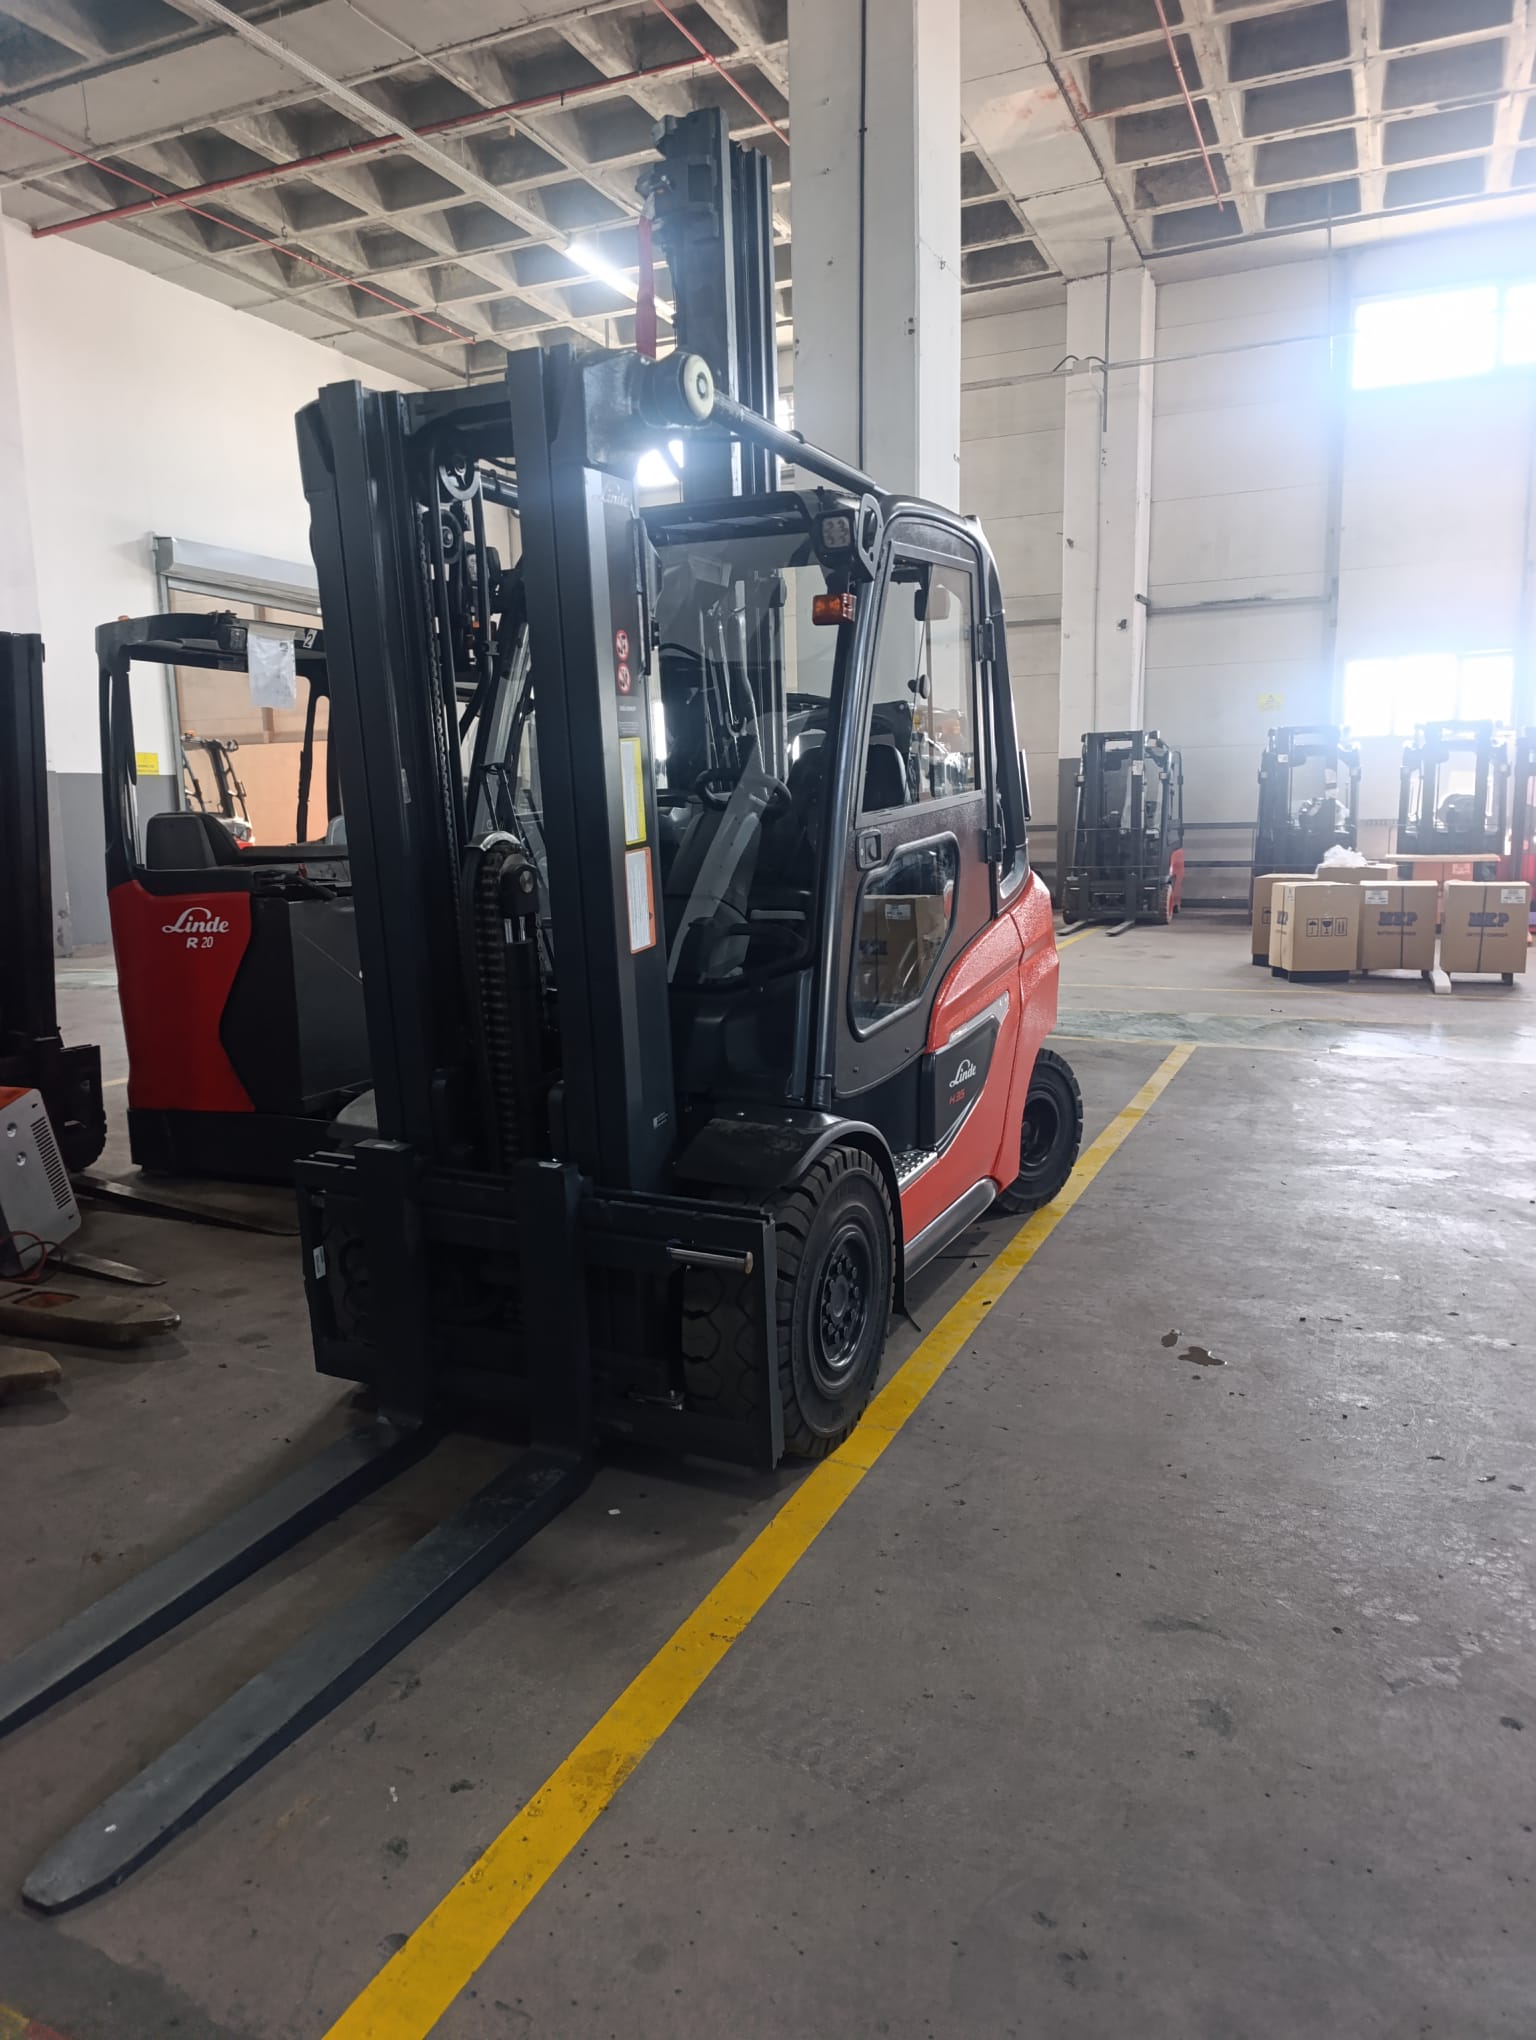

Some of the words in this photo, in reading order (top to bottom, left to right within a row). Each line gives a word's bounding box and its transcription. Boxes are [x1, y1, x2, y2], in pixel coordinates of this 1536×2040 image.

[304, 633, 314, 648] 2
[162, 907, 229, 933] Linde
[186, 937, 198, 949] R
[201, 936, 214, 948] 20
[949, 1059, 976, 1087] Linde
